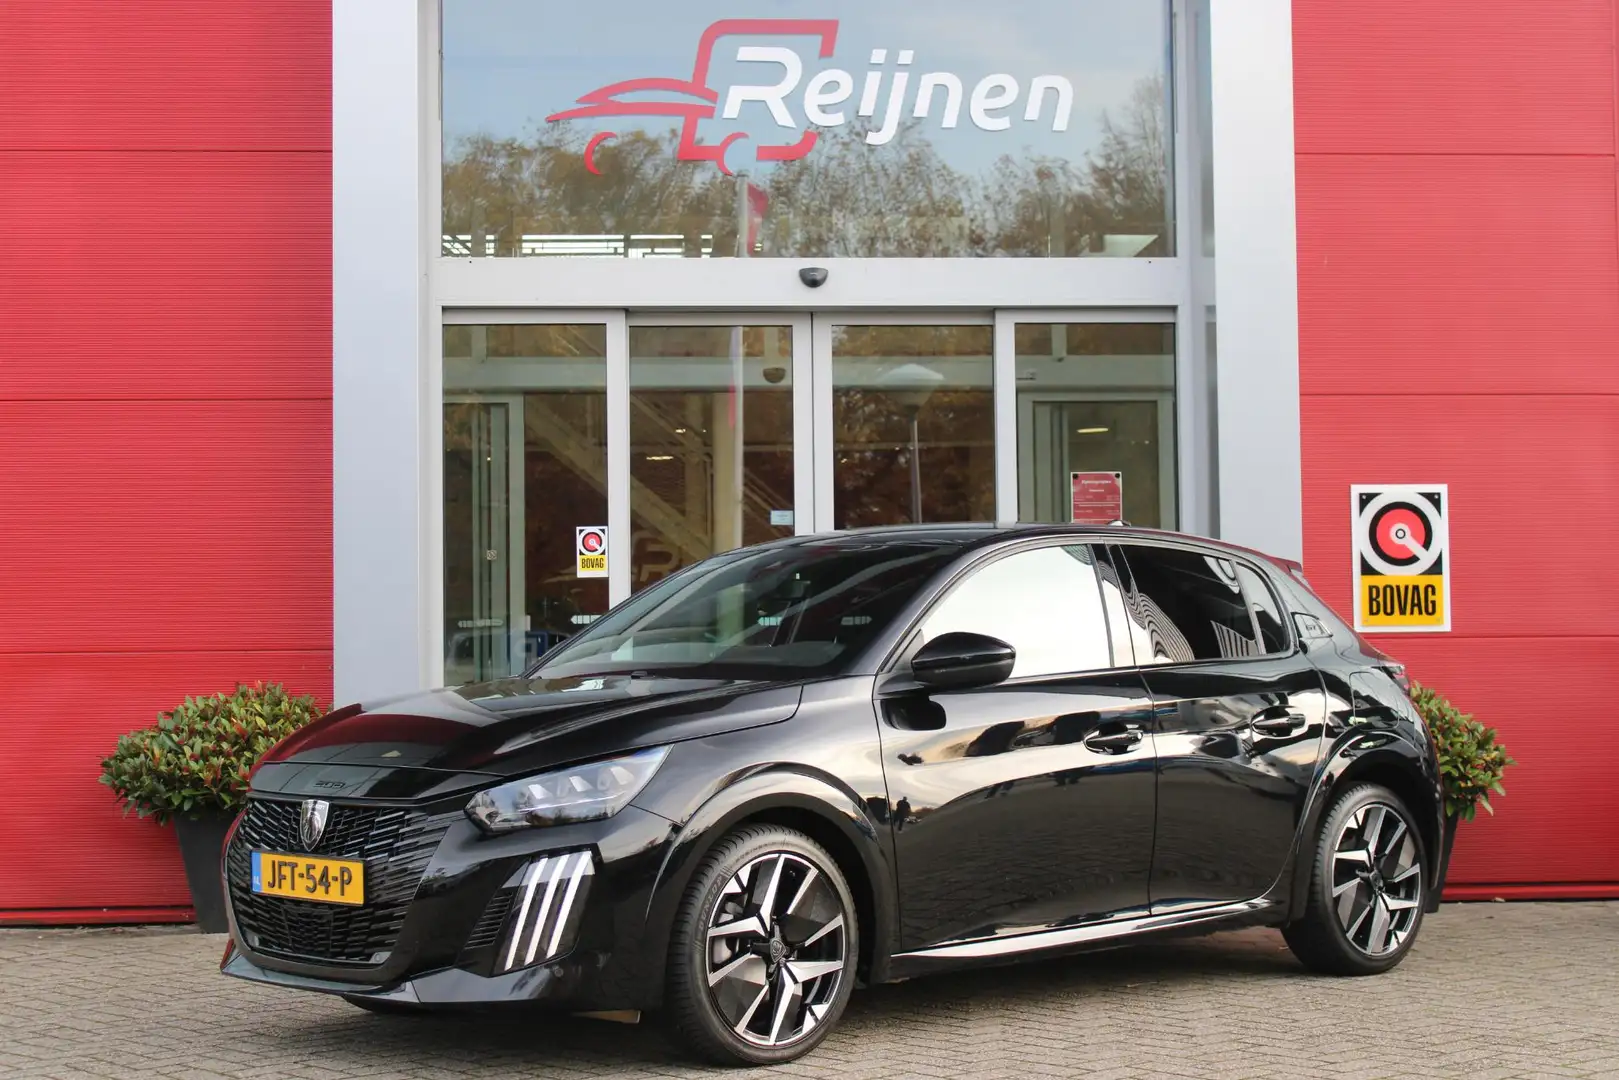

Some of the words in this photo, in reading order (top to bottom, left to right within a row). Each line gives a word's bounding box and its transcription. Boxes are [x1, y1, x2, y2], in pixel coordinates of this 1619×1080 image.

[722, 46, 1074, 145] Reijnen
[581, 557, 604, 569] BOVAG
[1368, 584, 1437, 617] BOVAG
[267, 860, 353, 897] JFT-54-P
